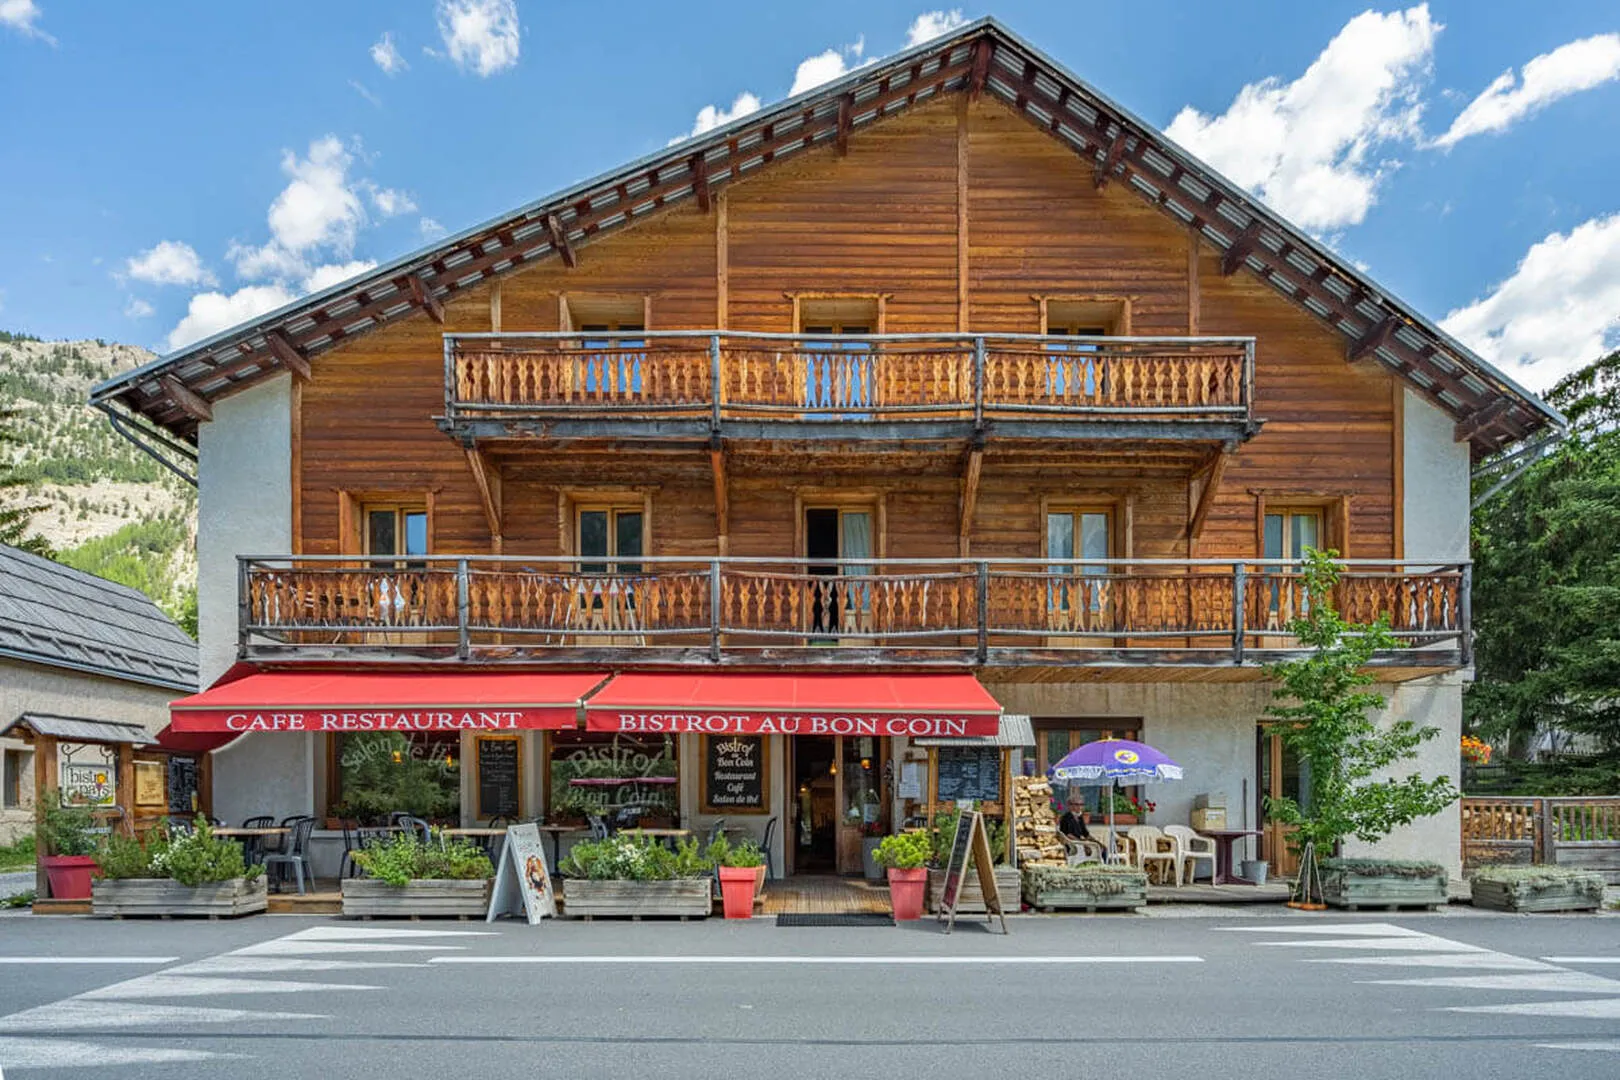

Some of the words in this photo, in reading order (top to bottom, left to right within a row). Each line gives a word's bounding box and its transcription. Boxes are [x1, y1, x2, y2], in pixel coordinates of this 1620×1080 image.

[226, 713, 305, 730] CAFE
[322, 711, 523, 730] RESTAURANT
[618, 714, 750, 732] BISTROT
[755, 715, 800, 733] AU
[809, 717, 878, 734] BON
[885, 718, 968, 736] COIN
